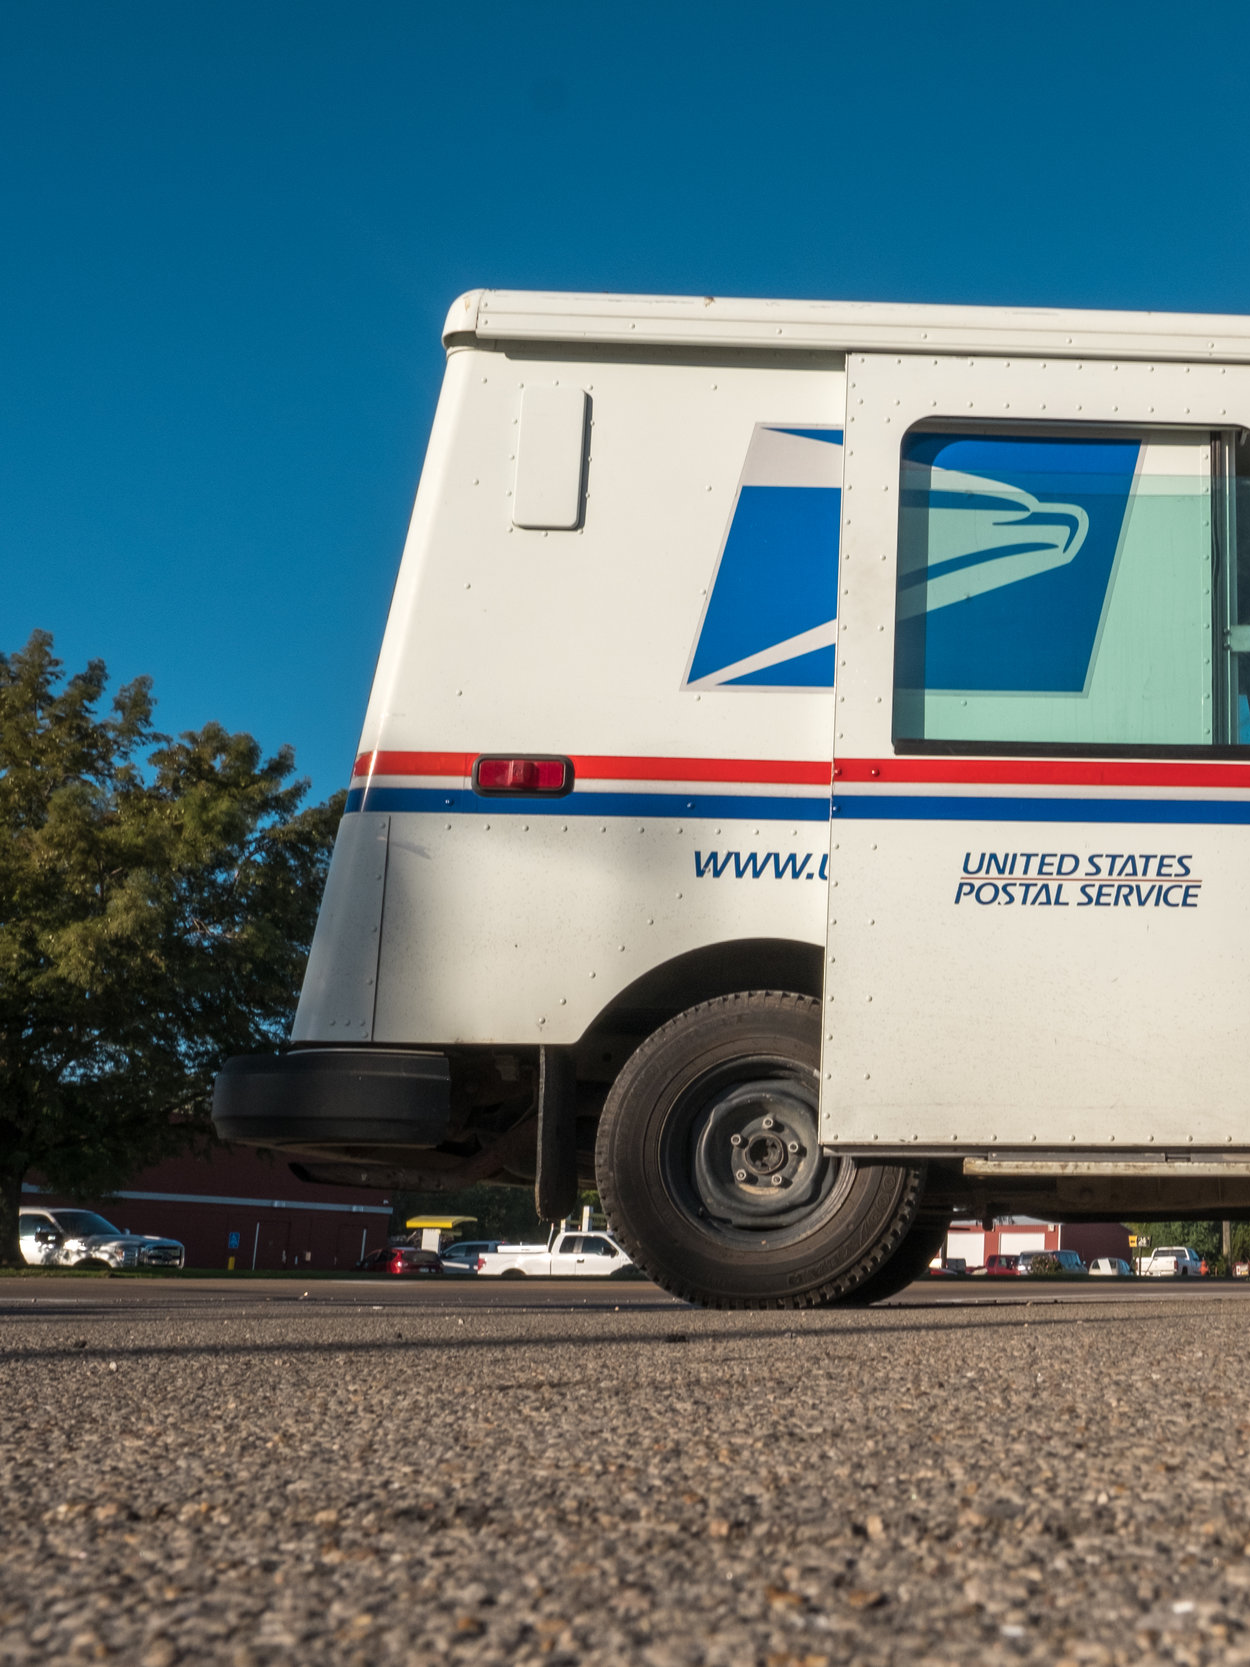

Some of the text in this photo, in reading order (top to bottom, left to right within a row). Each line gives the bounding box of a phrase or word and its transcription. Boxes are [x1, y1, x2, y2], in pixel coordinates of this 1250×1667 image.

[962, 852, 1193, 877] UNITED STATES
[954, 882, 1202, 908] POSTAL SERVICE
